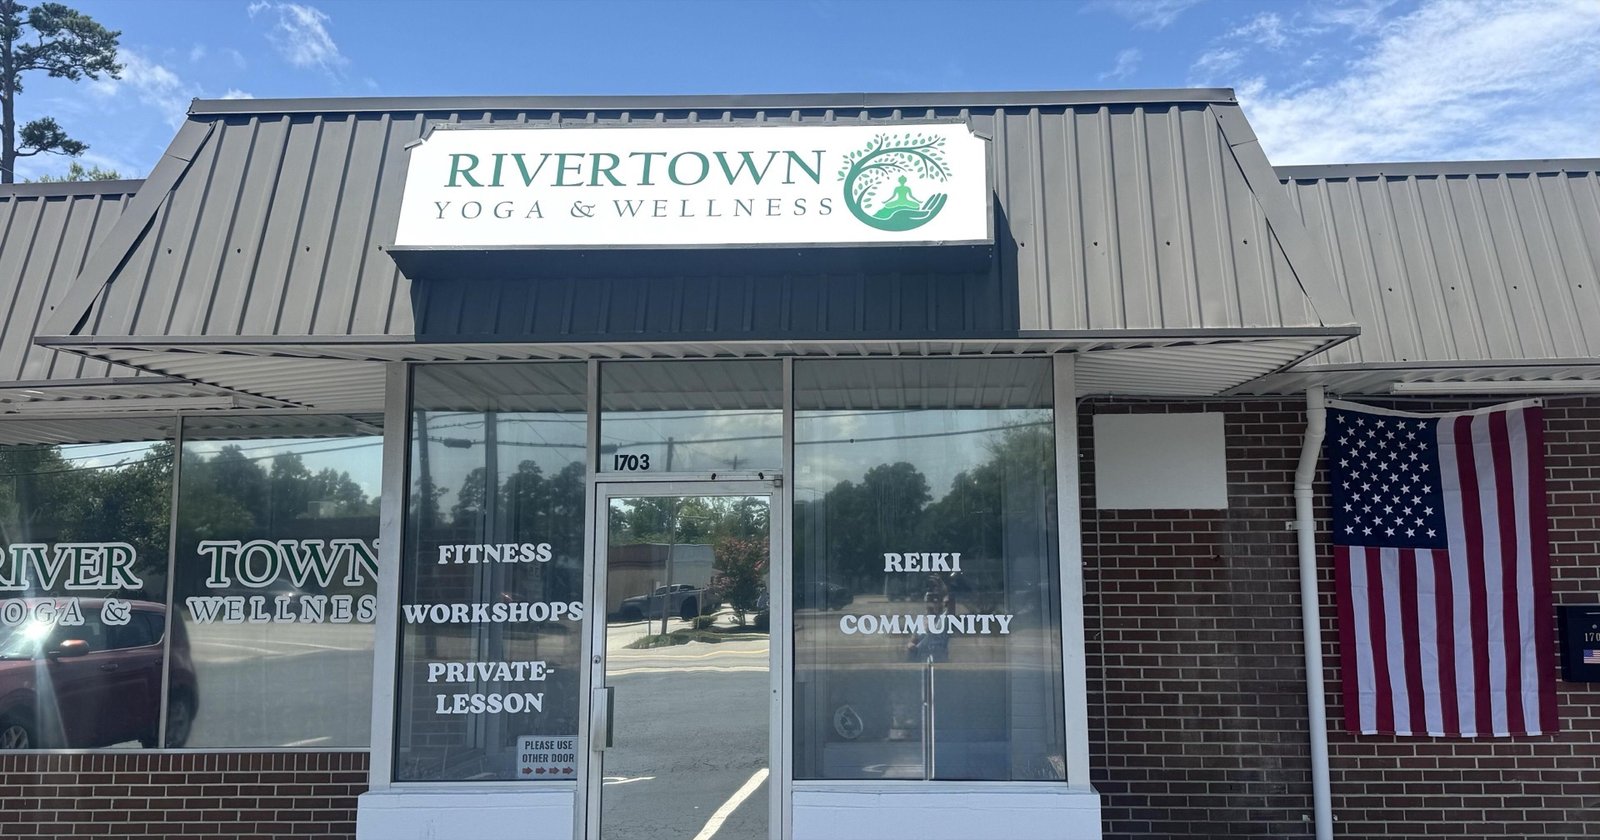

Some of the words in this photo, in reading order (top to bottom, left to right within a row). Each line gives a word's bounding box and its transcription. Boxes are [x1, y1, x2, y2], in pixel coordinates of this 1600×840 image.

[444, 150, 827, 187] RIVERTOWN
[434, 200, 545, 219] YOGA
[570, 200, 596, 218] &
[613, 198, 833, 218] WELLNESS
[613, 454, 650, 471] 1703
[198, 539, 379, 588] TOWN
[437, 543, 552, 565] FITNESS
[884, 552, 962, 572] REIKI
[0, 597, 85, 627] OGA
[101, 599, 131, 626] &
[186, 595, 377, 625] WELLNES
[402, 601, 584, 624] WORKSHOPS
[839, 614, 1014, 635] COMMUNITY
[427, 660, 555, 683] PRIVATE-
[435, 692, 544, 714] LESSON
[525, 740, 555, 750] PLEASE
[557, 740, 573, 750] USE
[522, 753, 549, 763] OTHER
[551, 753, 575, 763] DOOR
